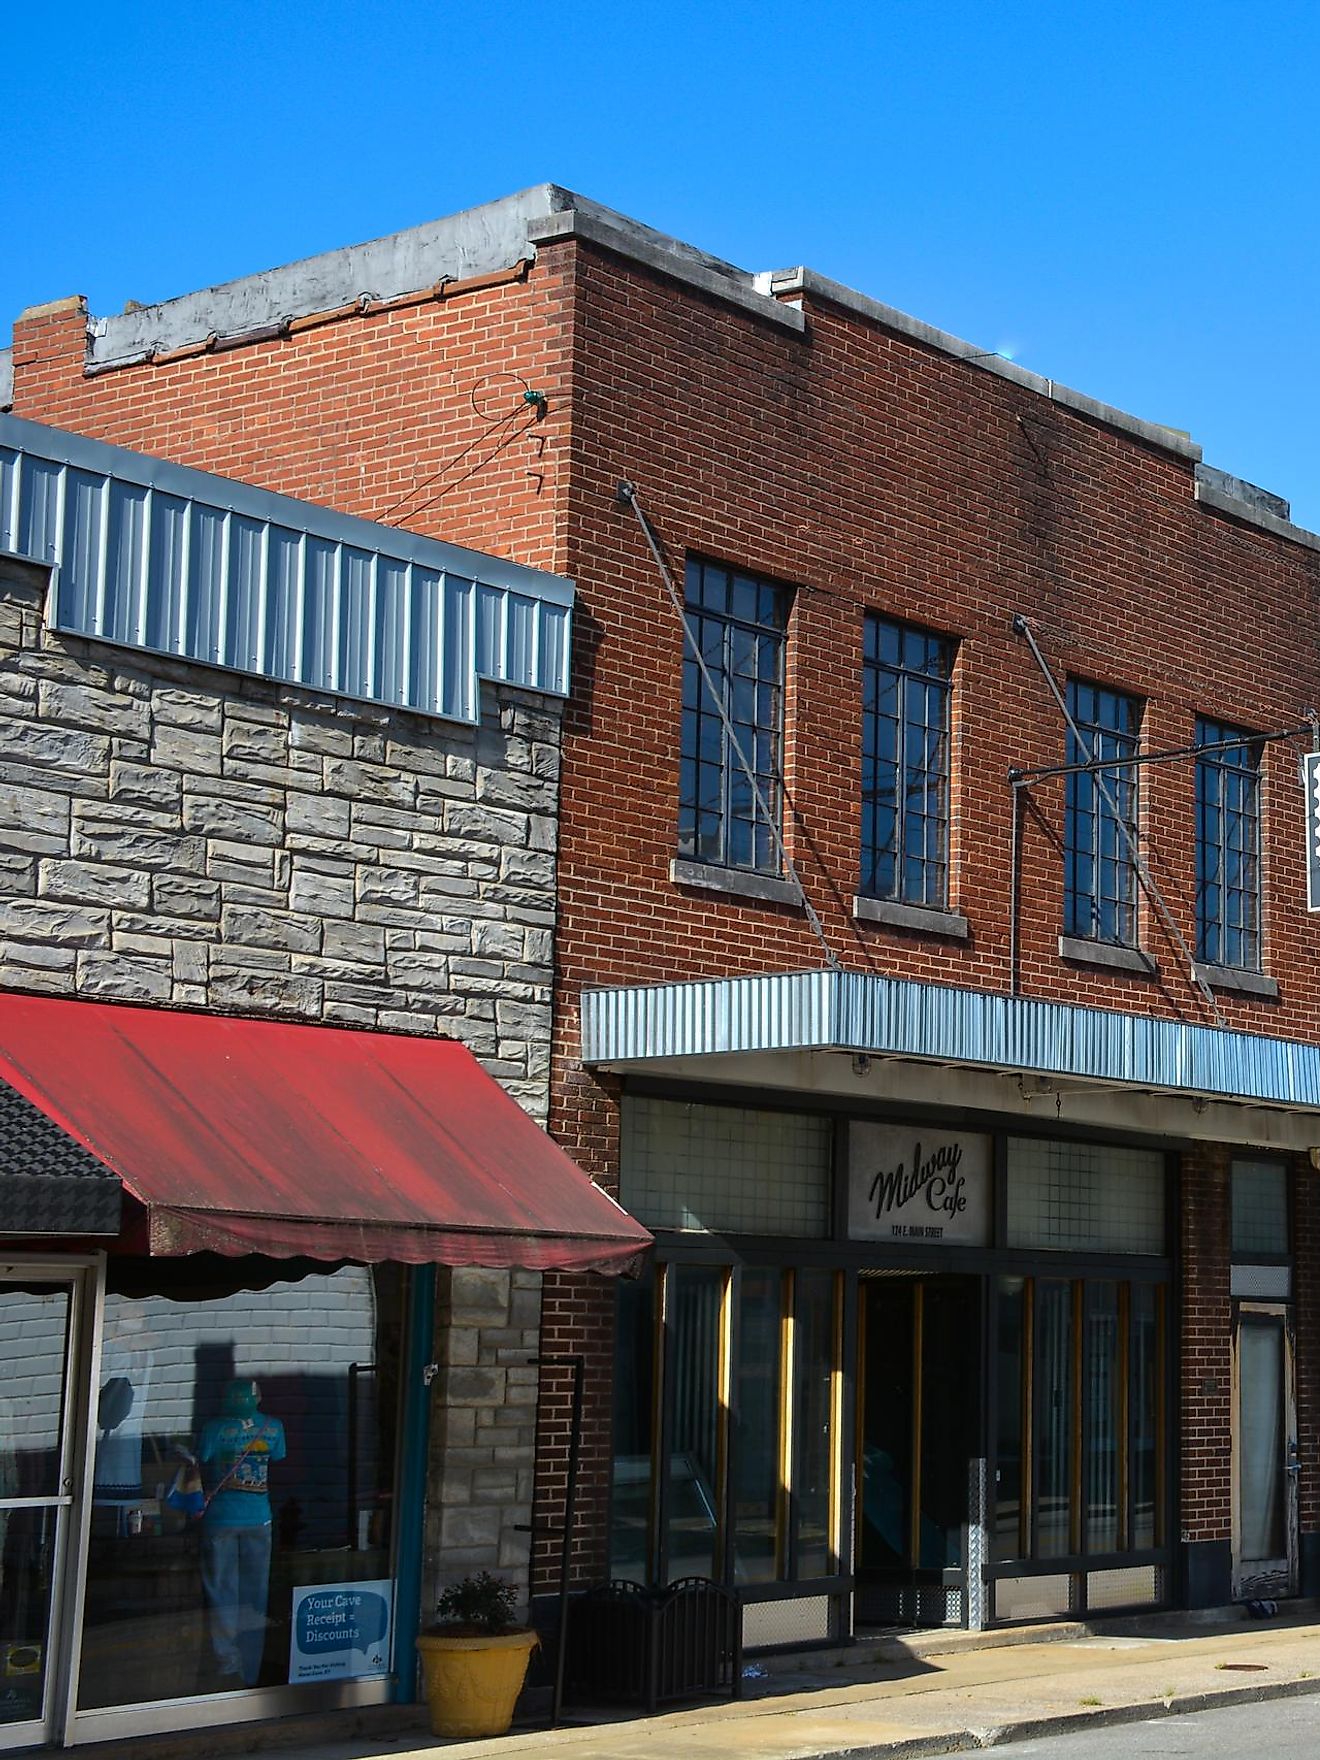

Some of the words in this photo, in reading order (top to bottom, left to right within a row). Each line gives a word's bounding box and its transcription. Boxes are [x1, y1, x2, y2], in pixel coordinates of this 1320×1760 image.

[868, 1142, 963, 1220] Midway
[926, 1177, 967, 1220] Cafe
[307, 1597, 333, 1611] Your
[335, 1595, 362, 1607] Cave
[306, 1612, 346, 1628] Receipt
[305, 1628, 360, 1643] Discounts
